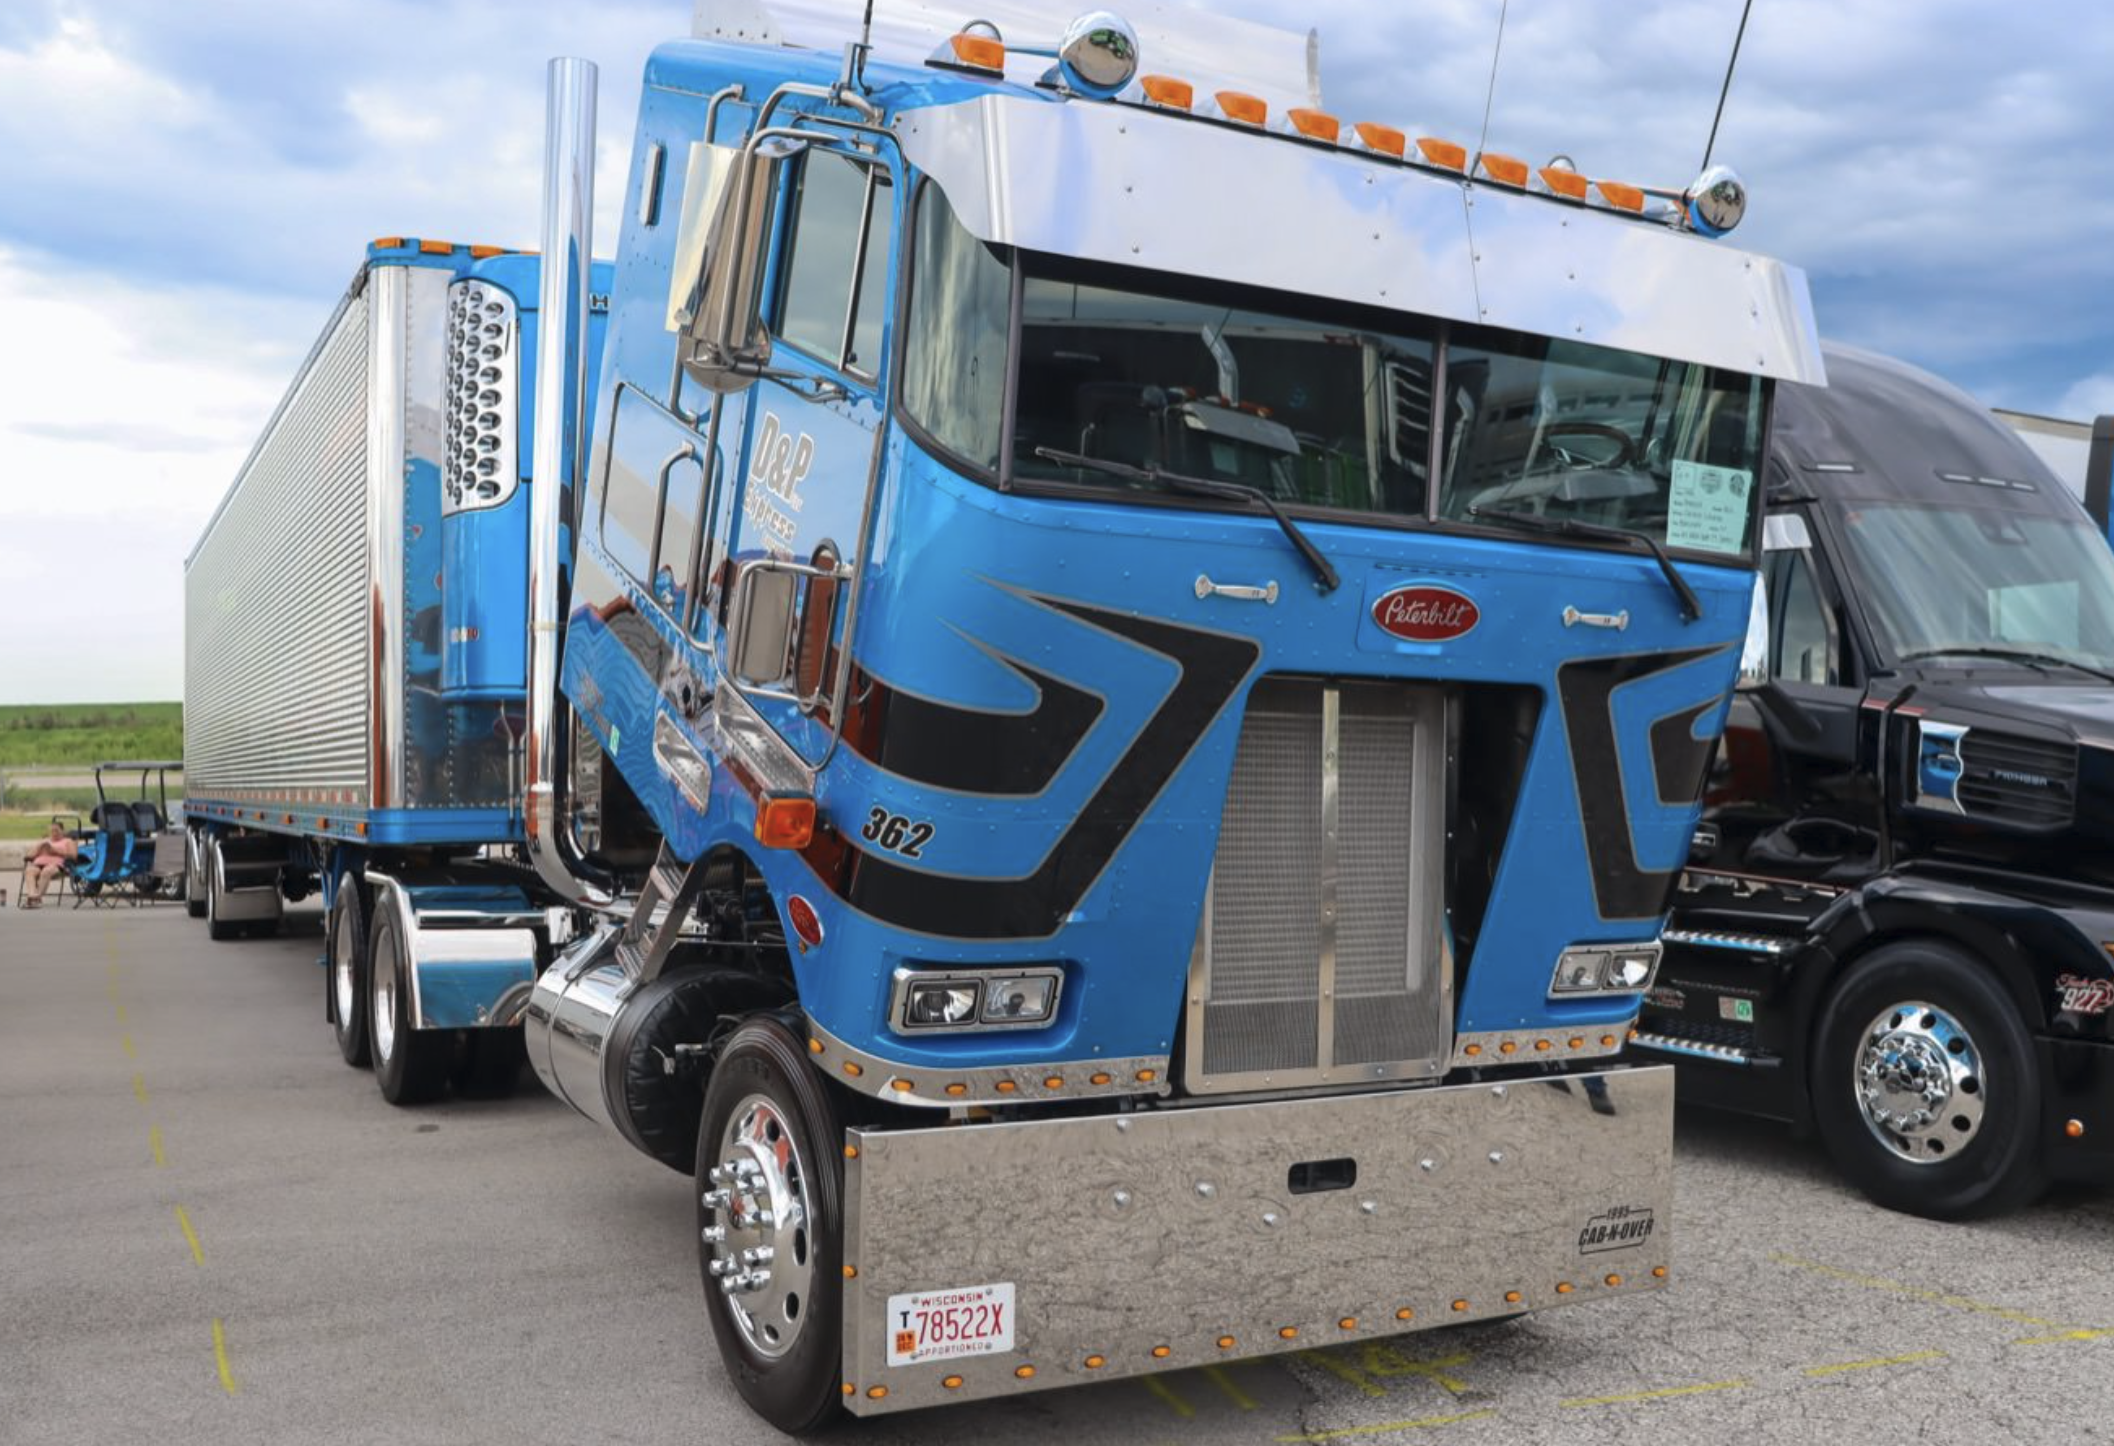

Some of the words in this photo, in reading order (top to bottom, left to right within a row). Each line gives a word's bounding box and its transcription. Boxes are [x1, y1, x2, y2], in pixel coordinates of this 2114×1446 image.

[751, 411, 815, 504] D&P
[1384, 594, 1472, 626] Peterbilt
[861, 805, 936, 860] 362
[1578, 1218, 1654, 1246] CAB-N-OVER
[921, 1292, 983, 1307] WISCONSIN
[900, 1310, 910, 1329] T
[915, 1302, 1003, 1345] 78522X
[919, 1342, 984, 1357] APPORTIONED
